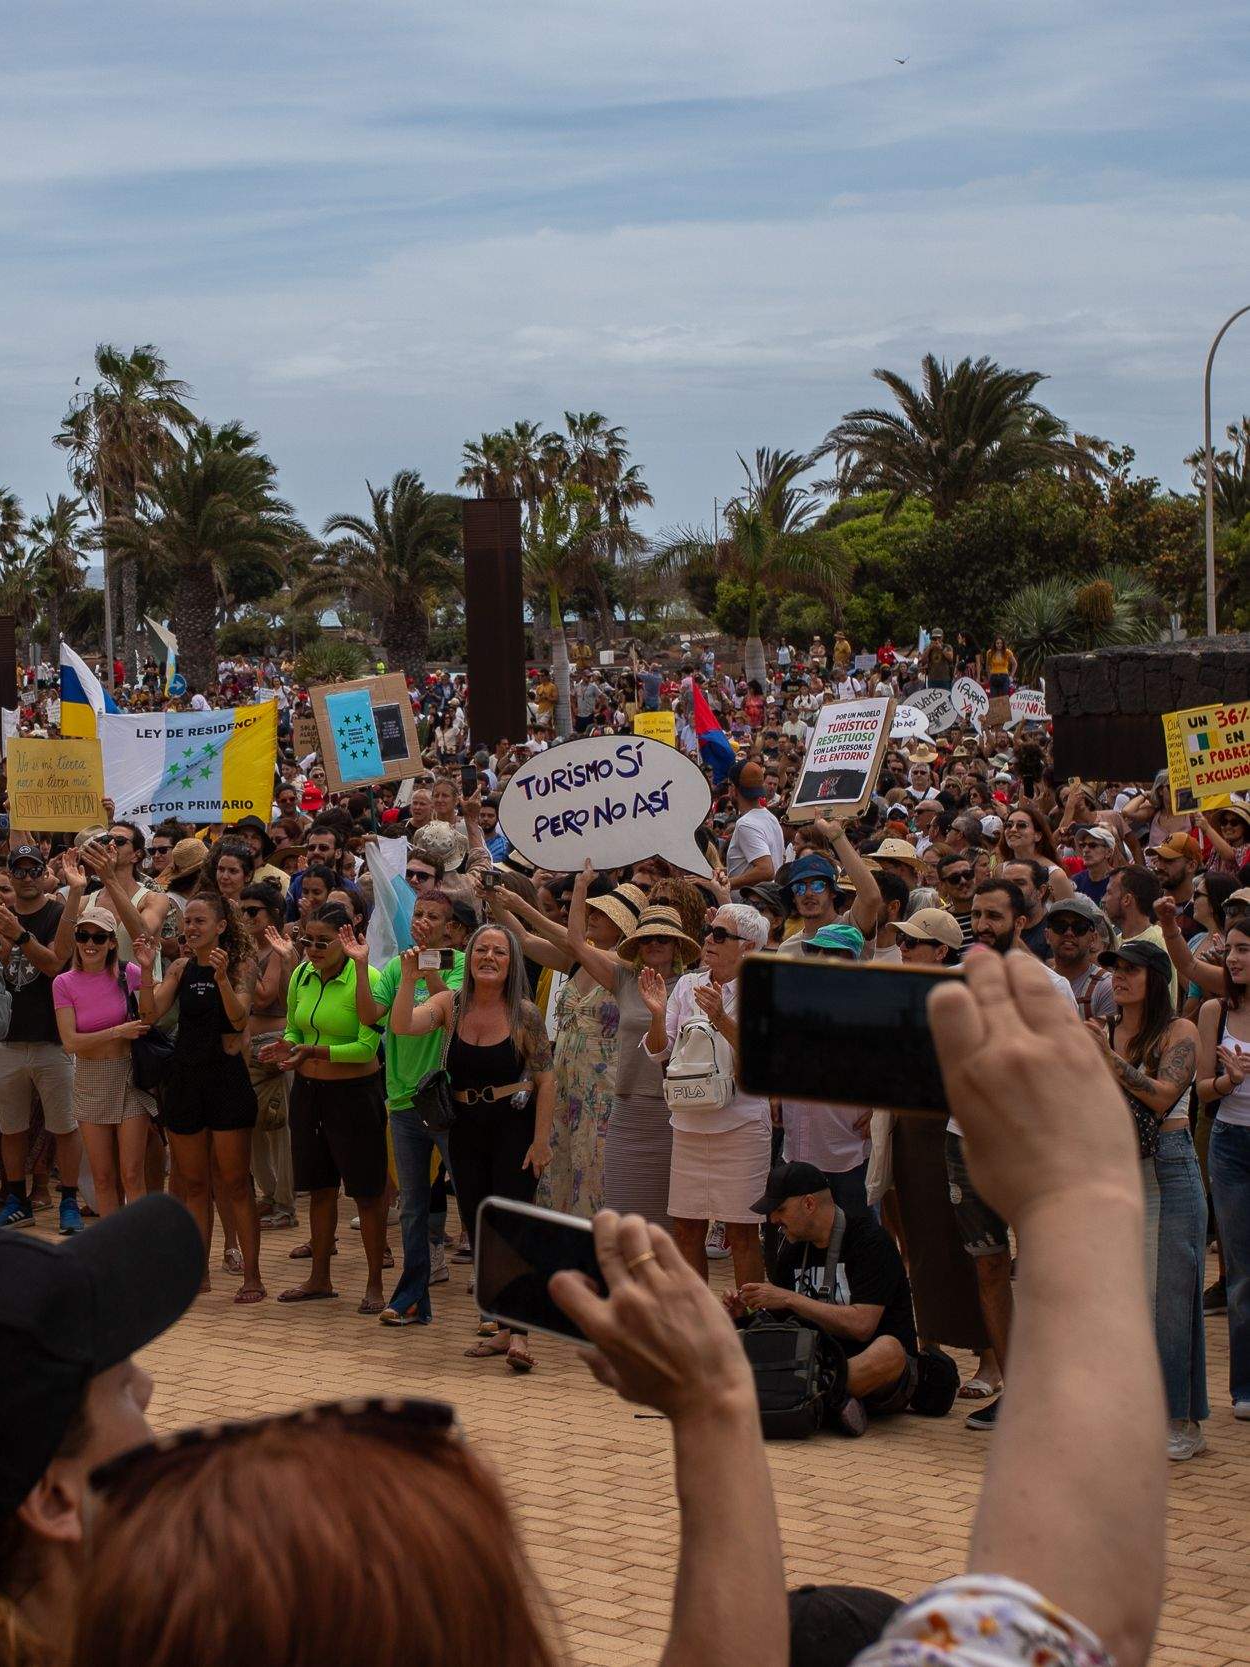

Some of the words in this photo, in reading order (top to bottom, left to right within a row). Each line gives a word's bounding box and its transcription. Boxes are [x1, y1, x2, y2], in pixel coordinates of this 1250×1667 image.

[835, 712, 847, 721] POR
[847, 711, 856, 719] UN
[856, 709, 881, 719] MODELO
[1187, 715, 1208, 729] UN
[1214, 706, 1250, 729] 36%
[136, 728, 162, 739] LEY
[166, 728, 184, 738] DE
[827, 719, 879, 734] TURÍSTICO
[816, 731, 876, 747] RESPETUOSO
[1225, 730, 1245, 744] EN
[813, 746, 825, 756] CON
[825, 745, 837, 755] LAS
[837, 743, 872, 752] PERSONAS
[616, 740, 645, 779] SÍ
[813, 754, 818, 765] Y
[818, 753, 828, 764] EL
[829, 751, 870, 763] ENTORNO
[1189, 755, 1205, 768] DE
[131, 801, 184, 816] SECTOR
[187, 799, 254, 811] PRIMARIO
[532, 809, 590, 842] PERO
[593, 797, 627, 829] NO
[632, 779, 673, 819] ASÍ
[673, 1085, 706, 1099] FILA
